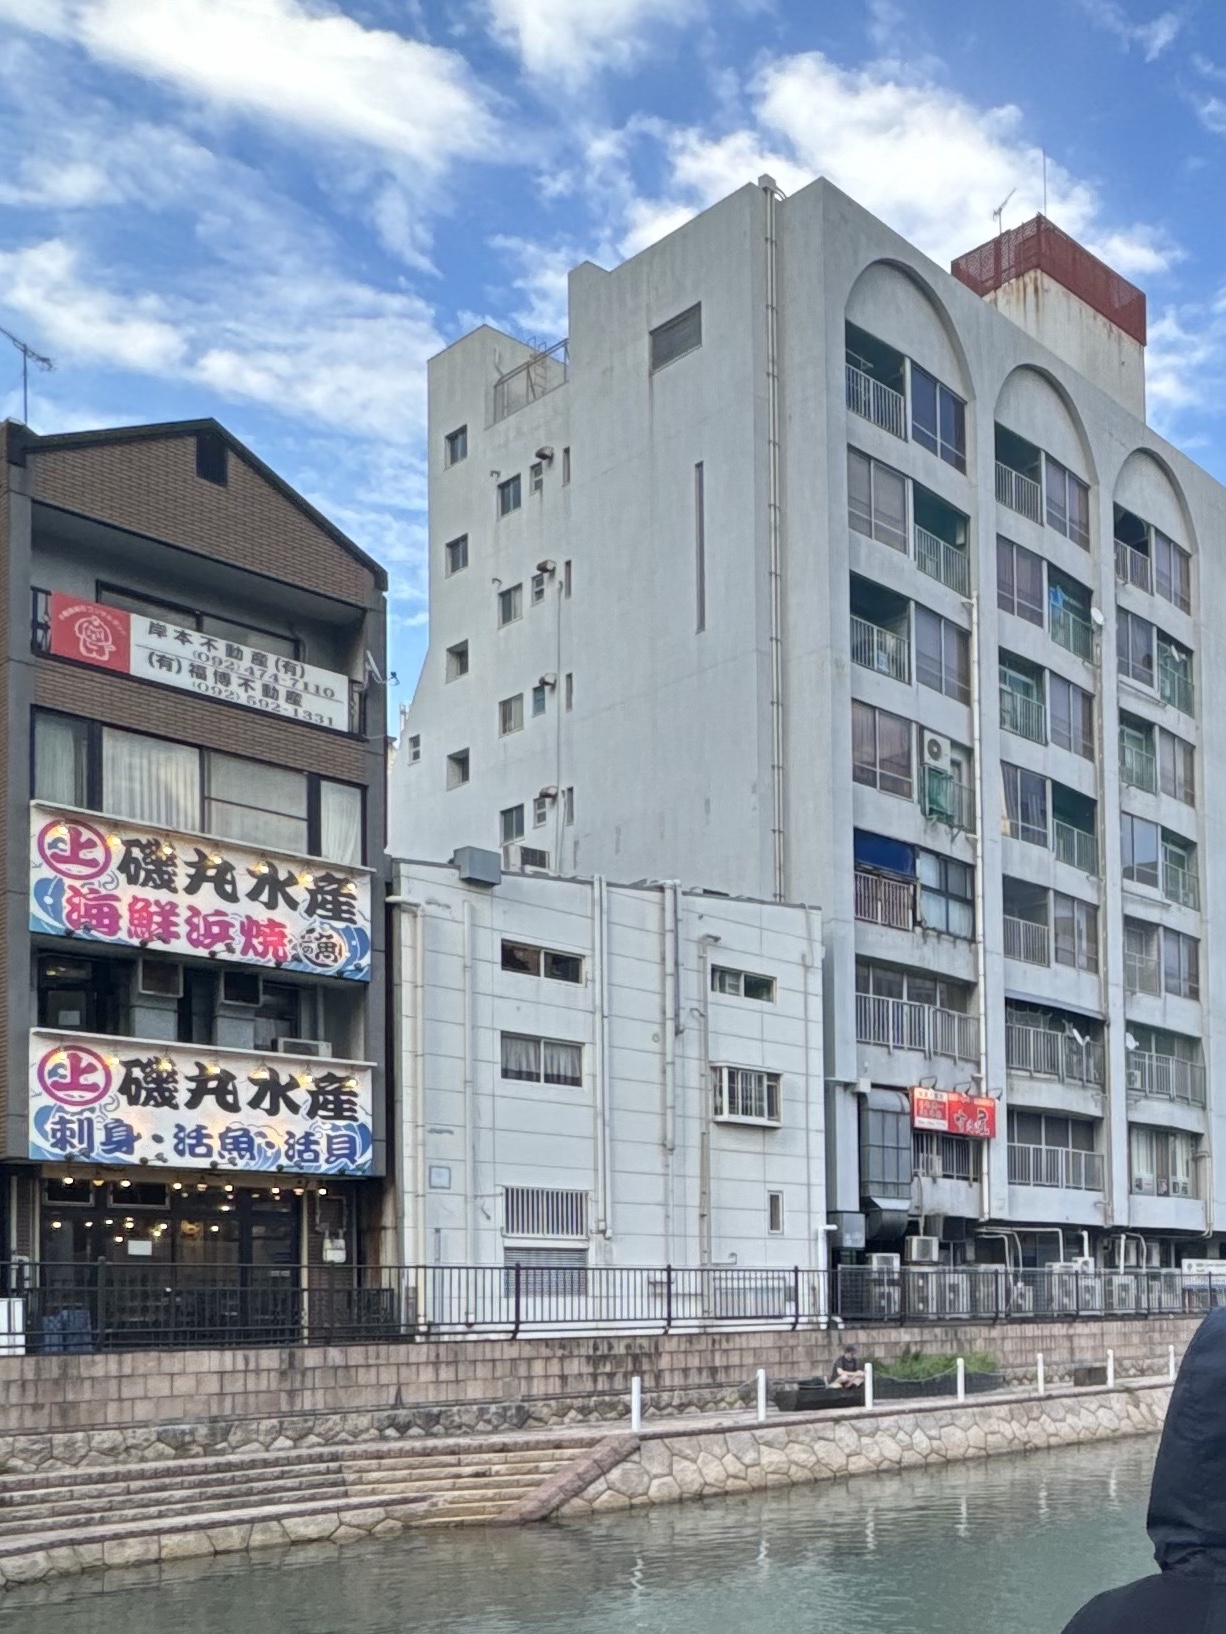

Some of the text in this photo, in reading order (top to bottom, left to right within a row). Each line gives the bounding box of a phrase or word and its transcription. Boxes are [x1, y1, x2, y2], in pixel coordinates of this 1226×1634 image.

[117, 837, 359, 926] 磯丸水産
[64, 882, 291, 964] 海鮮浜焼
[117, 1056, 359, 1122] 磯丸水産
